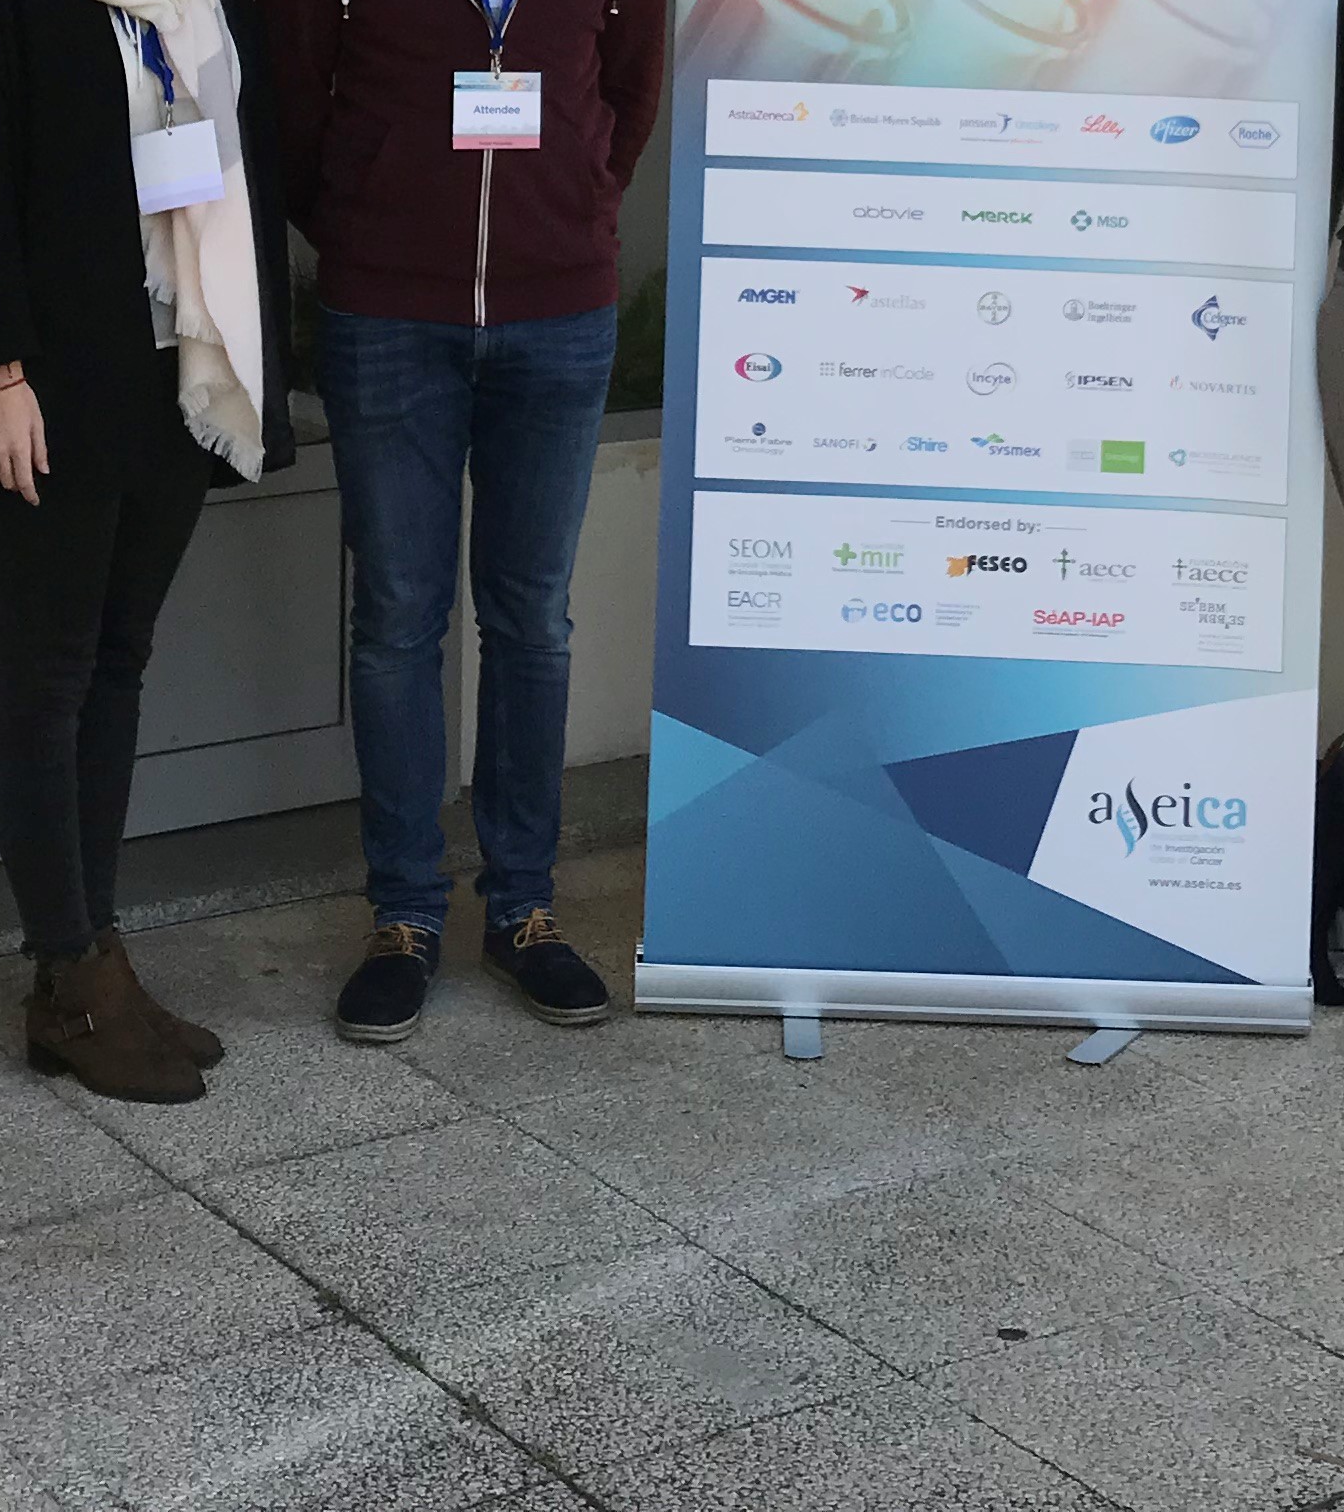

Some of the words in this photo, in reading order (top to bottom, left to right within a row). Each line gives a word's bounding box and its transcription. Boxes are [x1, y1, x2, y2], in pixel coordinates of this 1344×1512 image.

[473, 105, 521, 115] Attendee
[728, 108, 794, 121] AstraZeneca
[1080, 114, 1125, 138] Lilly
[1153, 119, 1199, 143] Pfizer
[1238, 128, 1272, 141] Roche
[852, 205, 924, 221] abbvie
[1096, 214, 1129, 228] MSD
[737, 288, 796, 304] AMGEN
[870, 295, 927, 310] astellas
[1203, 311, 1247, 326] Celgene
[838, 362, 878, 378] ferrer
[972, 372, 1012, 386] Incyte
[1077, 375, 1133, 387] IPSEN
[1189, 380, 1257, 396] NOVARTIS
[813, 438, 859, 450] SANOFI
[907, 437, 948, 453] Shire
[988, 445, 1041, 459] sysmex
[935, 515, 1011, 532] Endorsed
[1016, 518, 1041, 535] by:
[728, 538, 793, 560] SEOM
[1079, 562, 1136, 578] aecc
[1188, 566, 1249, 584] aecc
[727, 590, 782, 608] EACR
[872, 602, 923, 623] eco
[1088, 776, 1248, 850] aseica
[1148, 877, 1242, 891] www.aseica.es
